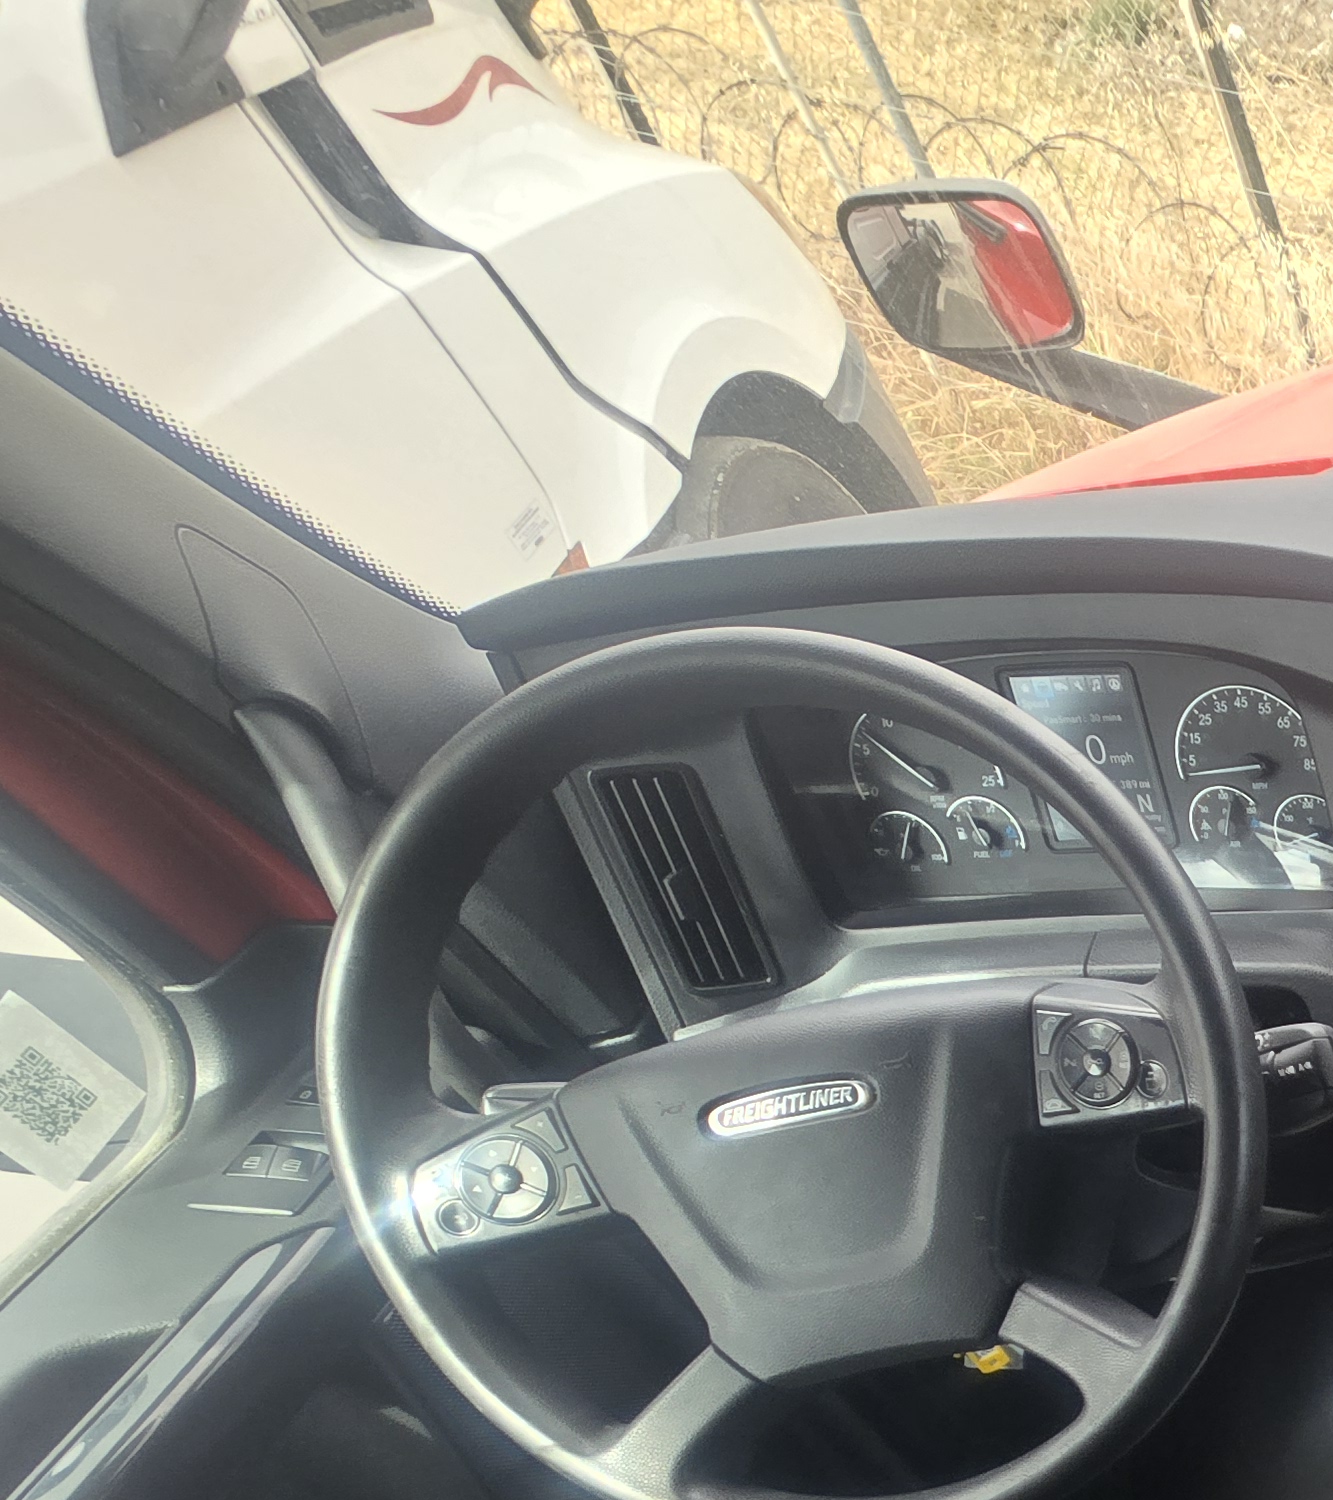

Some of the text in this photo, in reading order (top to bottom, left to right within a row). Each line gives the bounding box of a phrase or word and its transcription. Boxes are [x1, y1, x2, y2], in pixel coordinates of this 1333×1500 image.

[1214, 701, 1228, 713] 35
[1234, 697, 1248, 708] 45
[1258, 703, 1271, 715] 55
[1199, 714, 1212, 725] 25
[1277, 717, 1291, 728] 65
[1189, 733, 1201, 744] 15
[1293, 735, 1307, 747] 75
[862, 743, 870, 755] 5
[1085, 734, 1134, 766] 0 mph
[1188, 755, 1196, 766] 5
[981, 775, 995, 787] 25
[1136, 794, 1155, 813] N
[723, 1086, 853, 1127] FREIGHTLINER
